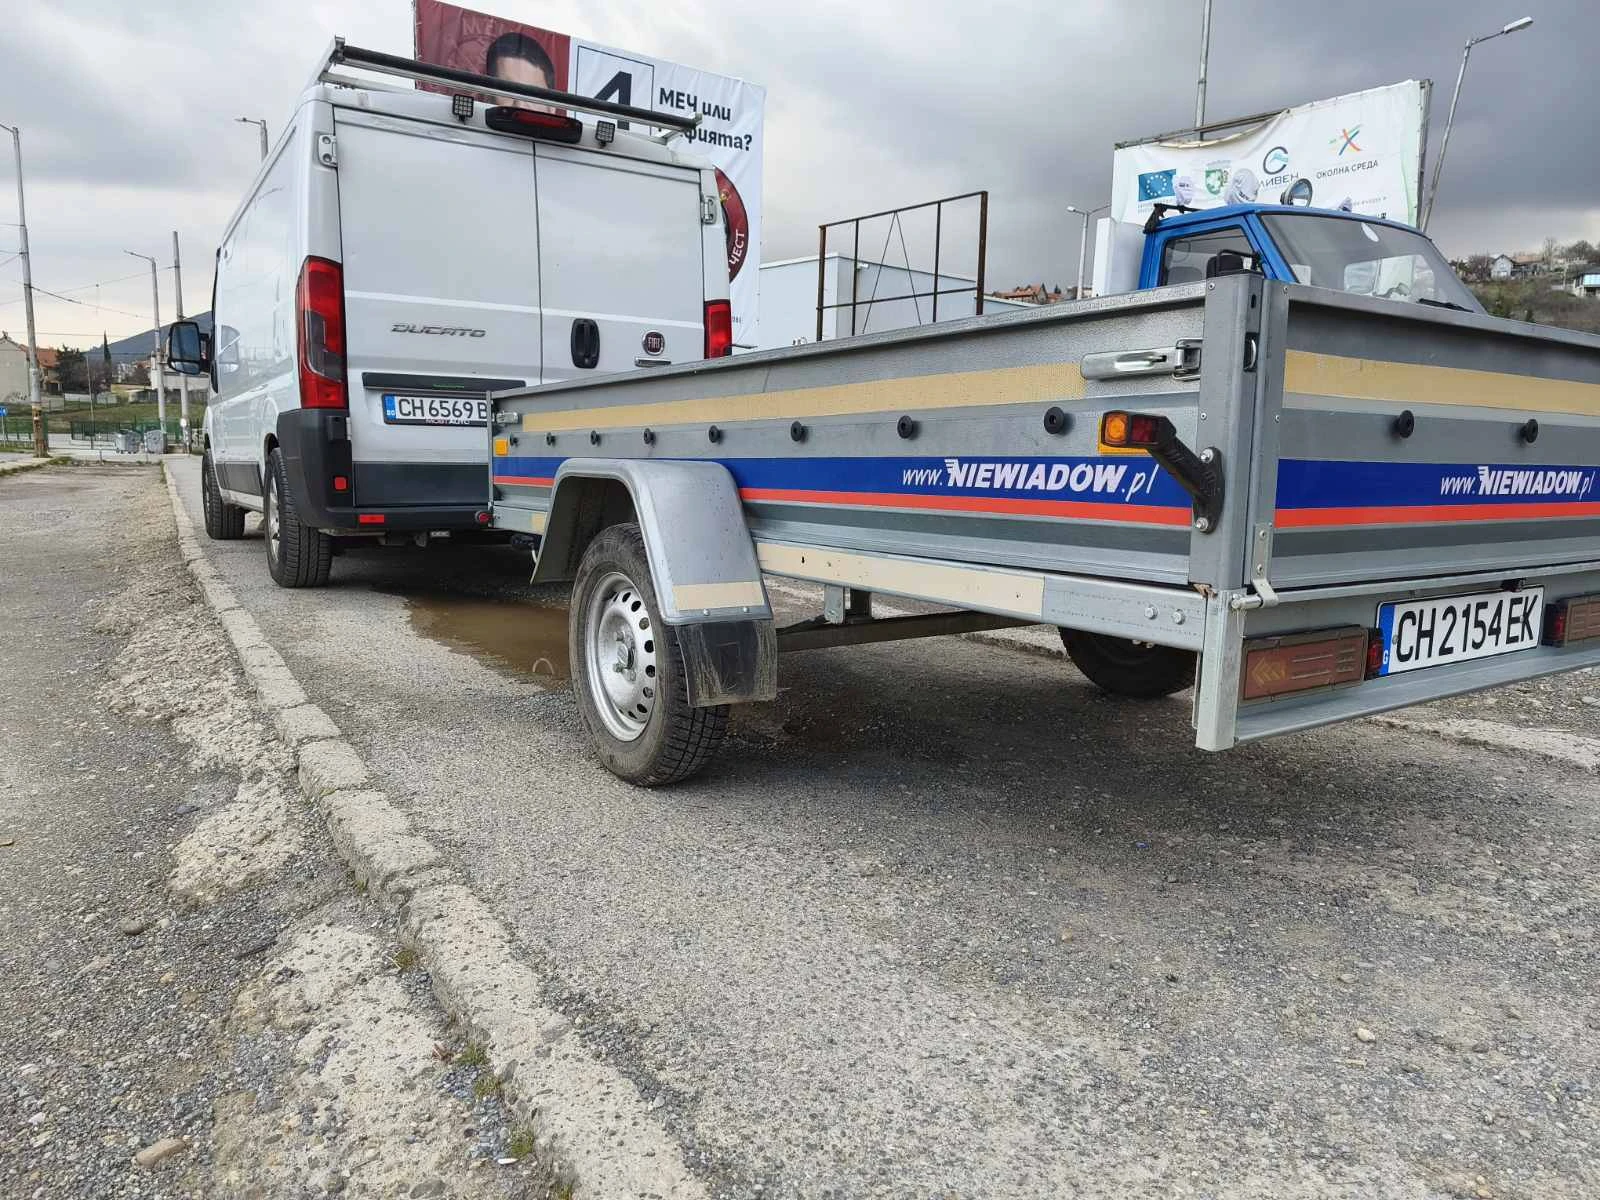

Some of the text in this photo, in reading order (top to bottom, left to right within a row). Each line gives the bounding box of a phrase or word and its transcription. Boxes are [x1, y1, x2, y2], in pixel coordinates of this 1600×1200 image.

[593, 71, 633, 131] 4
[659, 87, 731, 121] МЕЧ или
[678, 125, 753, 152] фията?
[1259, 172, 1300, 187] ЛИВЕН
[1316, 159, 1379, 180] ОКОЛНА СРЕДА
[729, 229, 745, 264] ЧЕСТ
[391, 324, 487, 338] DUCATO
[647, 337, 660, 349] FIAT
